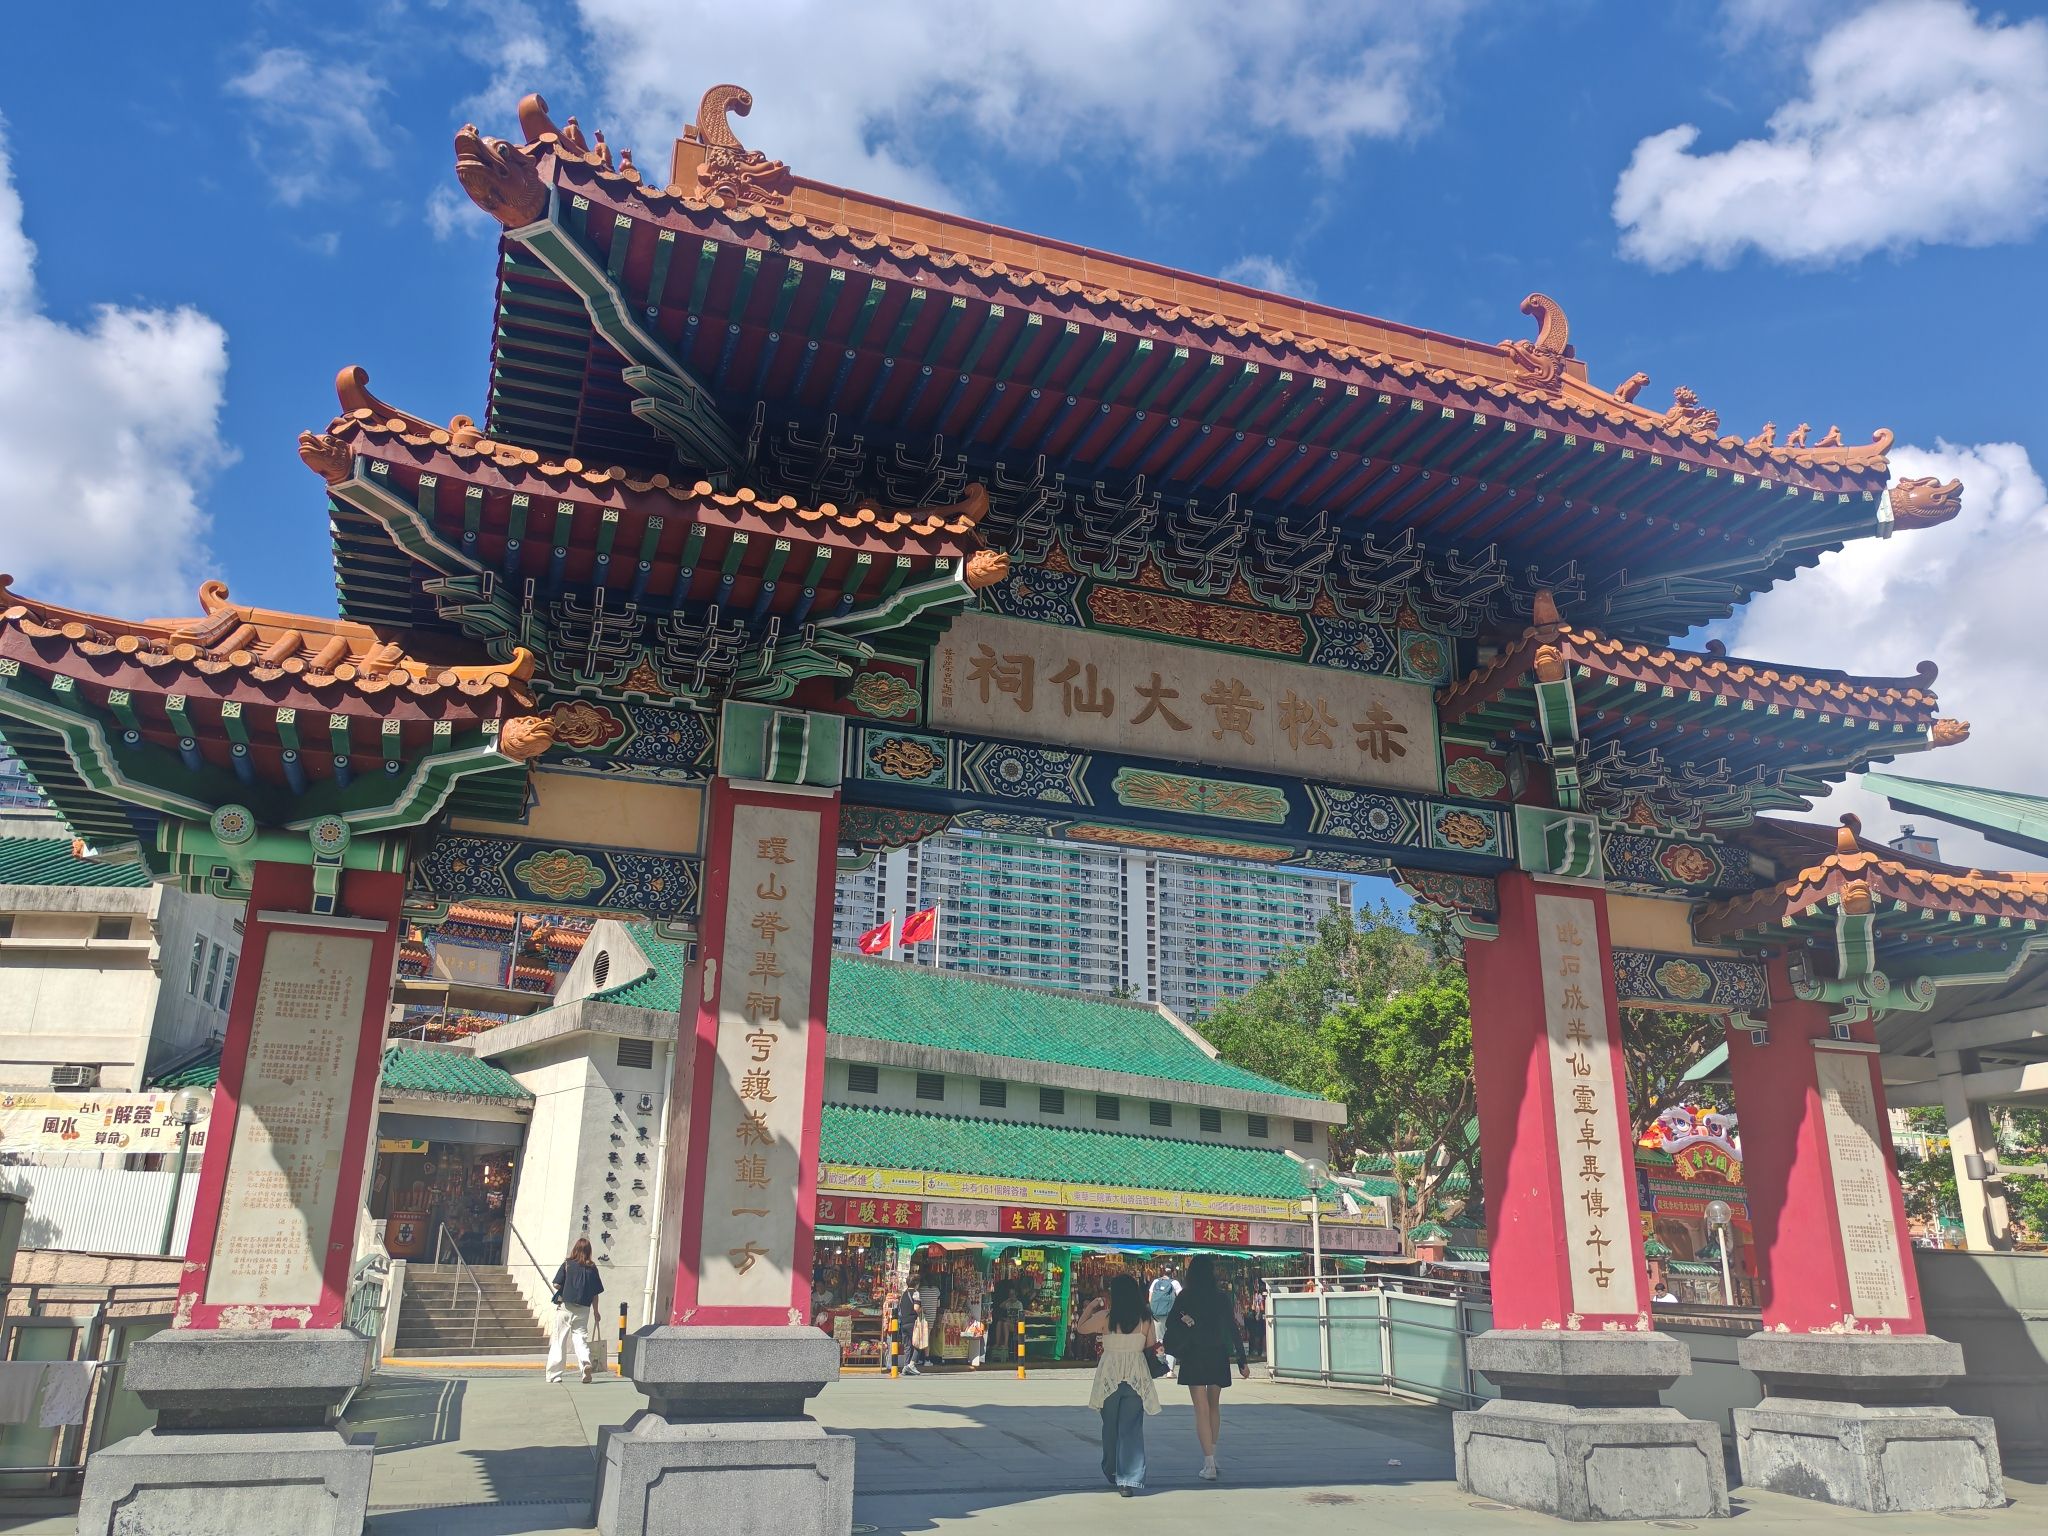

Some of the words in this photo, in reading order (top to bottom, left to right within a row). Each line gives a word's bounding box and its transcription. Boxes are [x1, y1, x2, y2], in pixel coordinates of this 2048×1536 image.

[966, 642, 1409, 764] 赤松黃大仙祠
[79, 1102, 101, 1113] 占卜
[113, 1105, 153, 1124] 解簽
[42, 1117, 78, 1134] 風水
[141, 1127, 160, 1138] 擇日
[94, 1132, 121, 1145] 算命
[629, 1127, 650, 1217] 東華三院
[828, 1172, 868, 1187] 歡迎內進
[818, 1199, 836, 1220] 記
